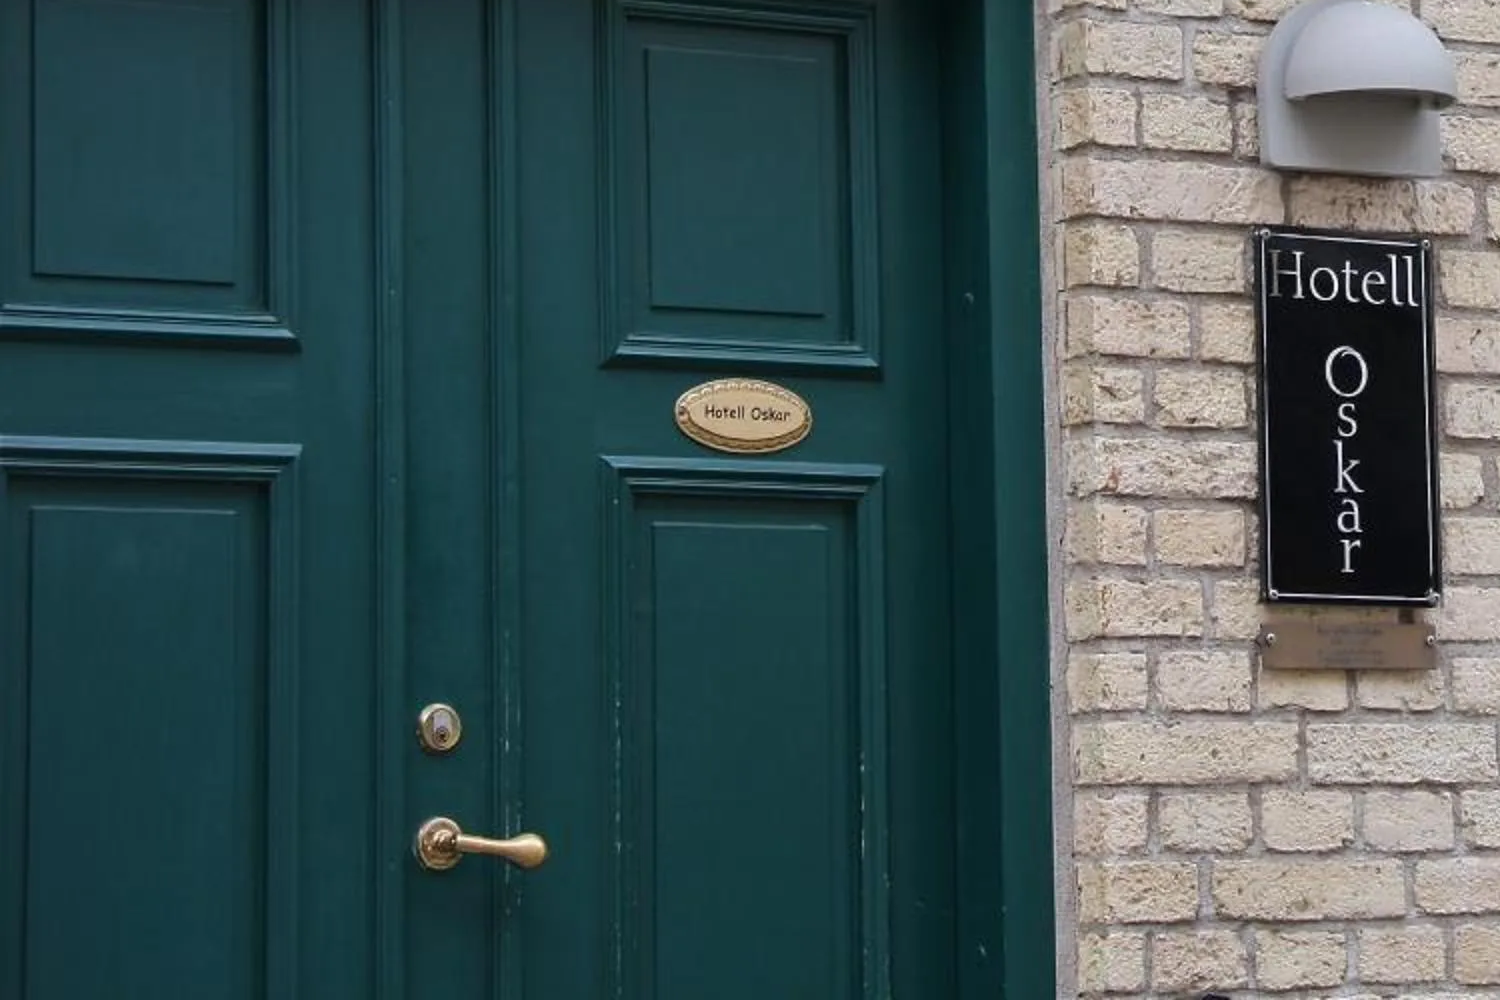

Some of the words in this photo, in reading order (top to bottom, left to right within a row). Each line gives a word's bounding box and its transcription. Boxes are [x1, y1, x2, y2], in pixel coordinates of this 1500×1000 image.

[1269, 248, 1420, 308] Hotell
[704, 403, 746, 420] Hotell
[751, 406, 791, 422] Oskar
[1324, 344, 1369, 575] Oskar
